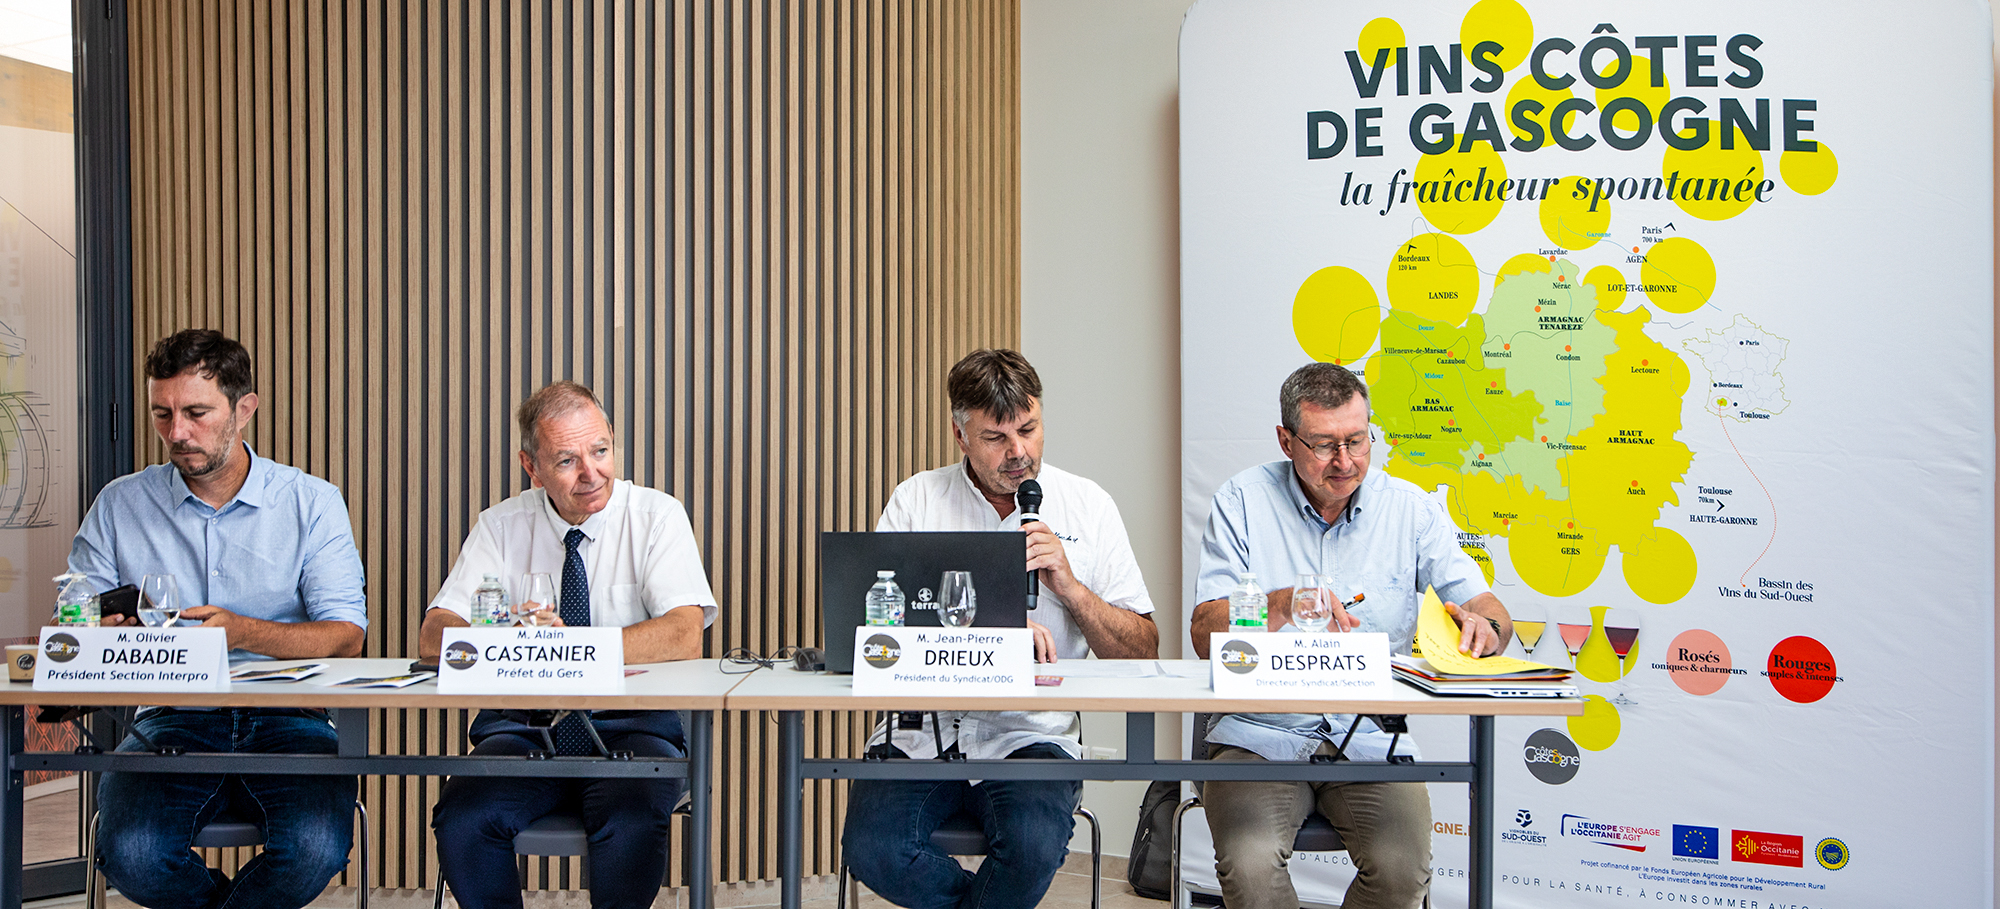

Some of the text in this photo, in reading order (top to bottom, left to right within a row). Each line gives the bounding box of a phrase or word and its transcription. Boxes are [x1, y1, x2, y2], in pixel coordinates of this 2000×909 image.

[1344, 22, 1764, 99] VINS CÔTES
[1307, 95, 1818, 160] DE GASCOGNE
[1340, 166, 1775, 216] la fraîcheur spontanée
[1641, 226, 1662, 235] Paris
[1398, 254, 1431, 262] Bordeaux
[1625, 255, 1648, 264] AGEN
[1552, 282, 1571, 290] Nérac
[1607, 284, 1678, 293] LOT-ET-GARONNE
[1428, 292, 1459, 300] LANDES
[1484, 350, 1512, 358] Montréal
[1630, 366, 1660, 374] Lectoure
[1485, 388, 1504, 396] Eauze
[1740, 411, 1771, 420] Toulouse
[1440, 426, 1462, 434] Nogaro
[1546, 442, 1587, 451] Vic-Fezensac
[1607, 437, 1655, 445] ARMAGNAC
[1470, 459, 1493, 468] Aignan
[1627, 487, 1646, 496] Auch
[1698, 486, 1733, 496] Toulouse
[1493, 511, 1518, 519] Marciac
[1690, 515, 1758, 526] HAUTE-GARONNE
[1557, 532, 1584, 541] Mirande
[1561, 548, 1581, 556] GERS
[1758, 577, 1814, 591] Bassin des
[1718, 586, 1814, 603] Vins du Sud-Ouest
[911, 600, 940, 610] terra
[117, 632, 177, 643] M. Olivier
[517, 629, 564, 640] M. Alain
[917, 633, 1004, 644] M. Jean-Pierre
[1294, 638, 1341, 649] M. Alain
[101, 649, 188, 665] DABADIE
[485, 645, 596, 662] CASTANIER
[924, 650, 995, 666] DRIEUX
[1678, 647, 1720, 663] Rosés
[1270, 655, 1367, 671] DESPRATS
[1773, 654, 1831, 674] Rouges
[497, 667, 584, 679] Préfet du Gers
[1651, 662, 1748, 676] toniques & charmeurs
[48, 669, 209, 683] Président Section Interpro
[894, 673, 1014, 685] Président du Syndicat/ODG
[1760, 670, 1794, 680] souples
[1806, 673, 1844, 682] intenses
[1256, 678, 1376, 689] Directeur Syndicat/Section
[1524, 746, 1580, 767] Gascogne
[1577, 822, 1661, 836] L'EUROPE S'ENGAGE
[1502, 832, 1547, 843] SUD-OUEST
[1571, 829, 1641, 841] L'OCCITANIE AGIT
[1760, 845, 1800, 855] Occitanie
[1300, 852, 1349, 866] D'ALCO
[1581, 860, 1599, 868] Projet
[1600, 862, 1629, 871] cofinancé
[1671, 869, 1701, 878] Européen
[1702, 872, 1728, 881] Agricole
[1755, 877, 1807, 889] Développement
[1808, 882, 1826, 890] Rural
[1638, 873, 1665, 882] L'Europe
[1667, 876, 1690, 884] investit
[1740, 883, 1763, 891] rurales
[1502, 874, 1541, 887] POUR
[1549, 880, 1566, 890] LA
[1639, 888, 1647, 898] À
[1656, 891, 1758, 909] CONSOMMER
